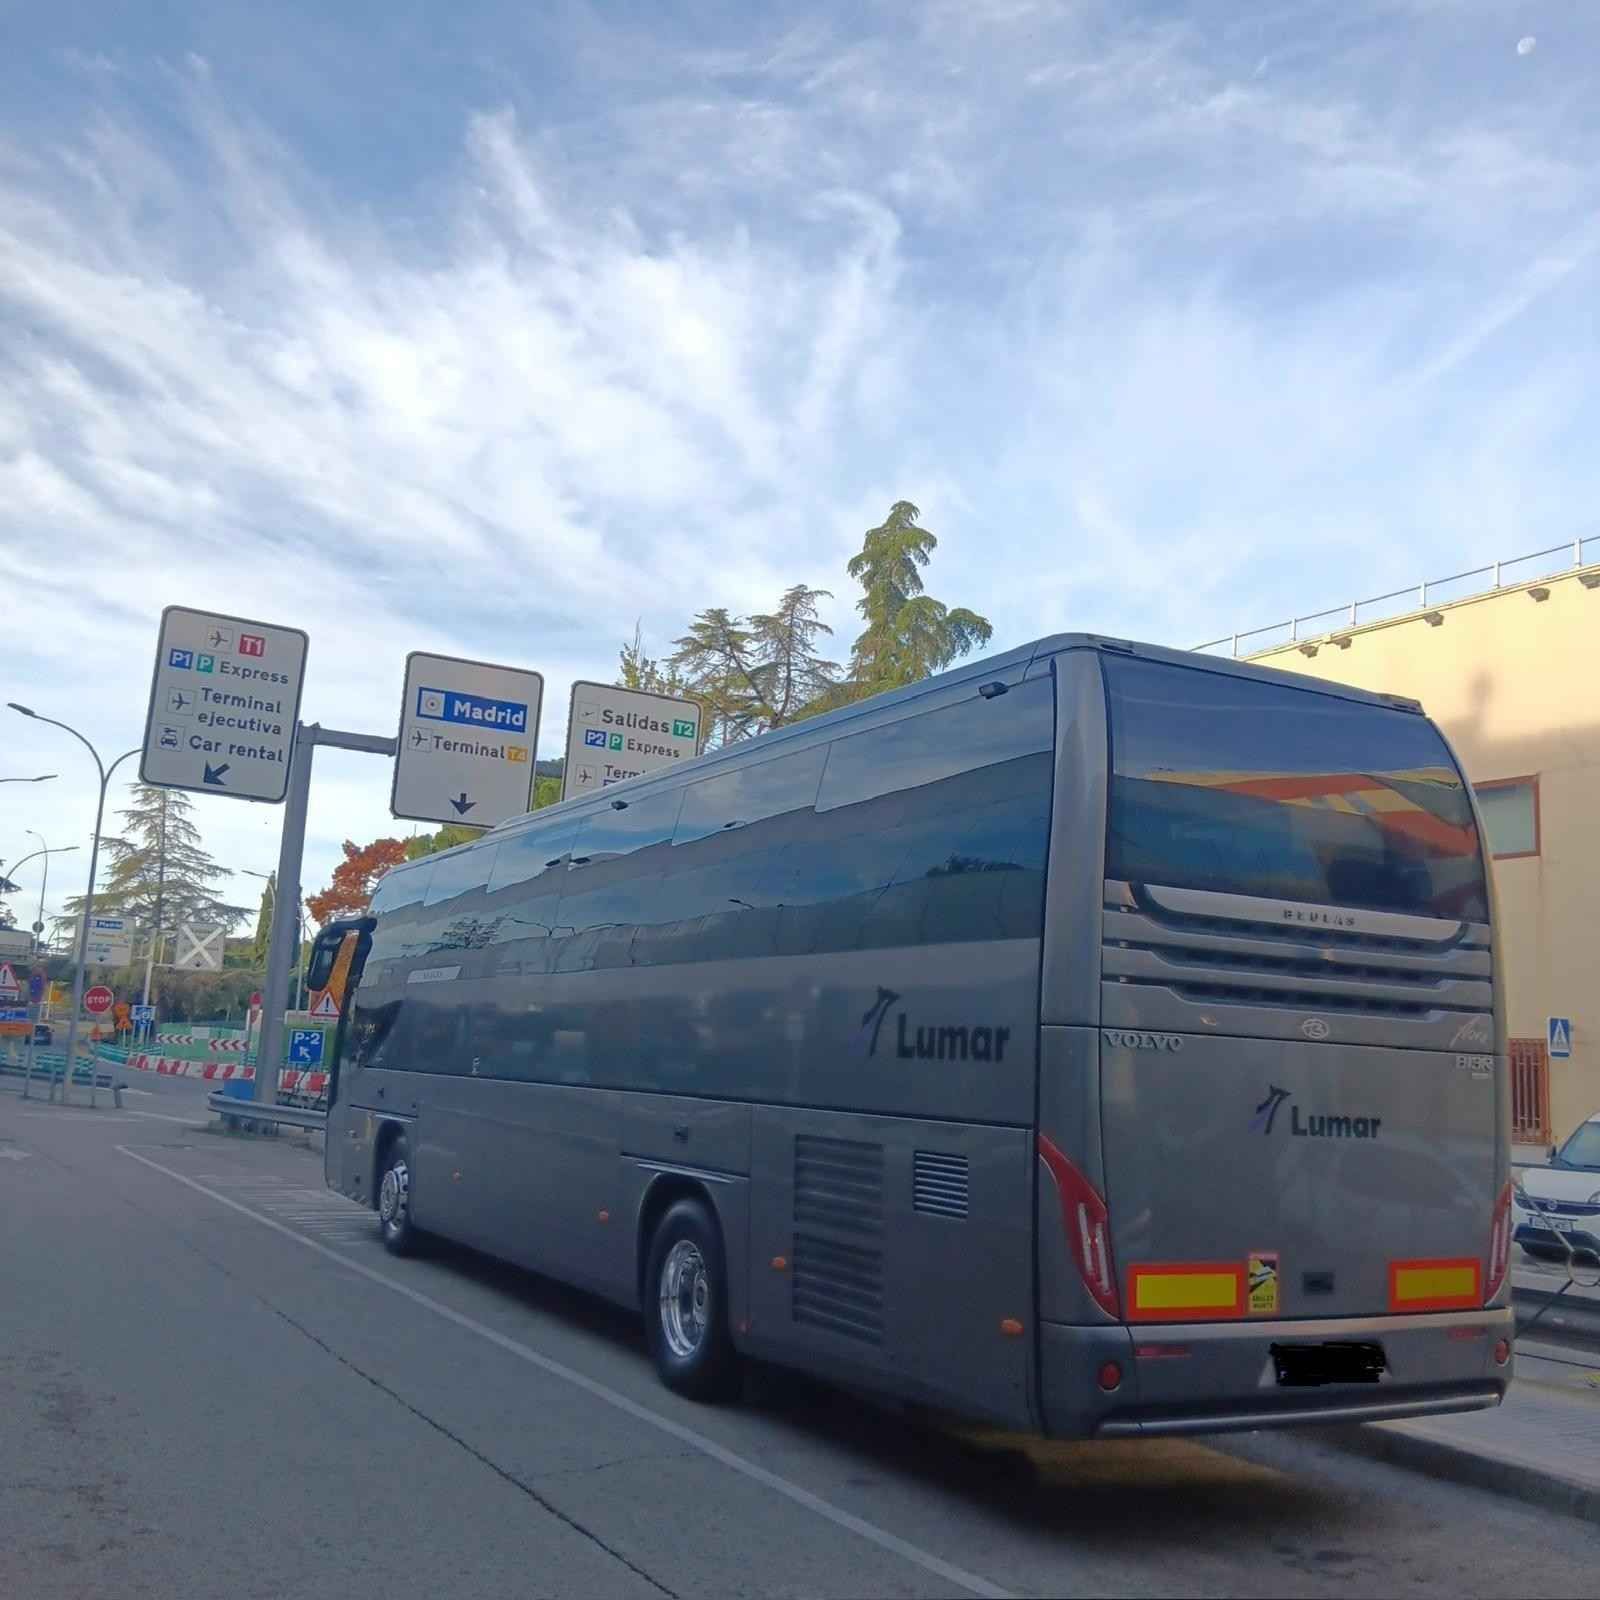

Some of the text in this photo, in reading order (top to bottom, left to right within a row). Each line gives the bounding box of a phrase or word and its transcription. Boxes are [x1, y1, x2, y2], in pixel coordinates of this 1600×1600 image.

[242, 636, 263, 655] T1
[172, 653, 289, 685] P1 P Express
[201, 687, 282, 715] Terminal
[453, 699, 525, 727] Madrid
[198, 711, 282, 735] ejecutiva
[602, 709, 693, 736] Salidas T2
[189, 735, 284, 762] Car rental
[433, 735, 505, 759] Terminal
[587, 732, 680, 758] P2 P Express
[294, 1032, 320, 1045] P-2
[897, 1012, 1010, 1063] Lumar
[1104, 1031, 1184, 1053] VOLVO
[1291, 1105, 1381, 1138] Lumar
